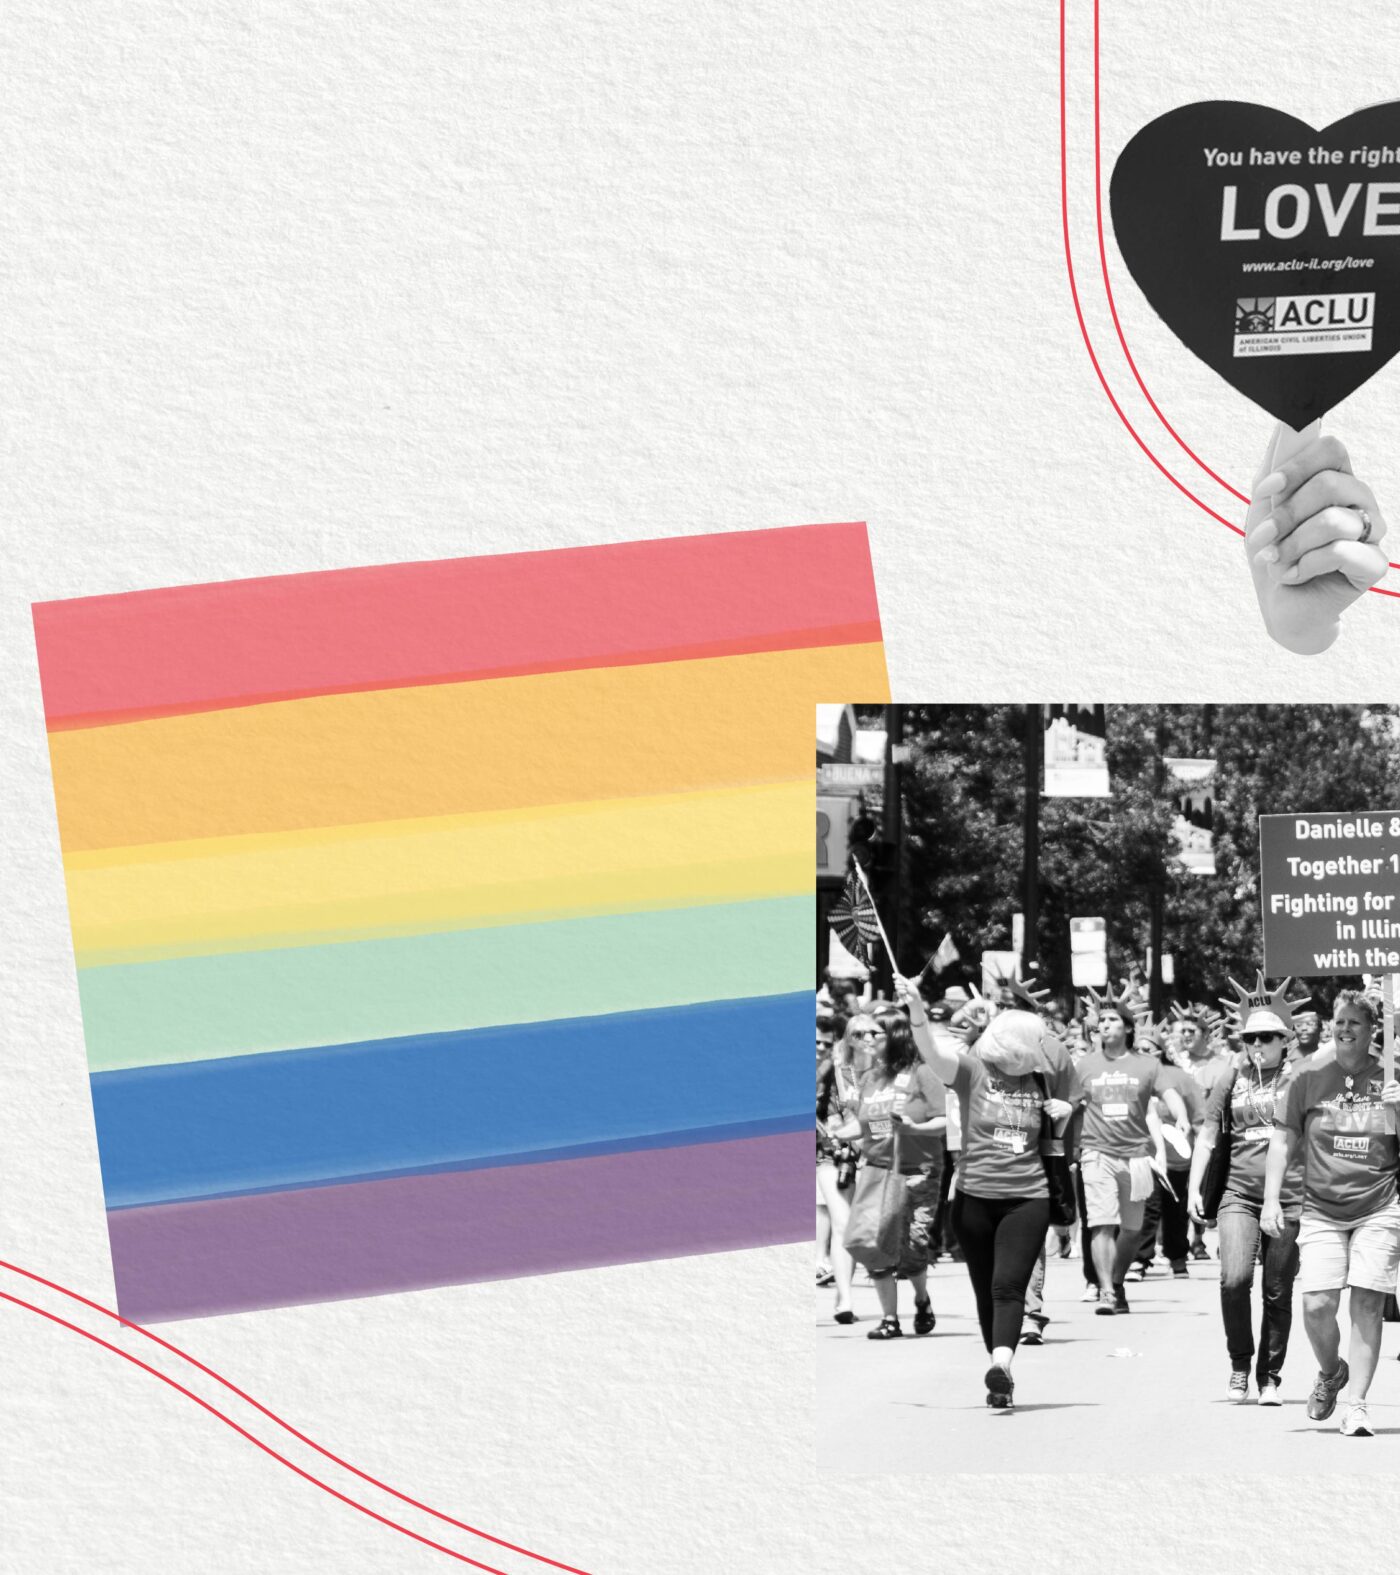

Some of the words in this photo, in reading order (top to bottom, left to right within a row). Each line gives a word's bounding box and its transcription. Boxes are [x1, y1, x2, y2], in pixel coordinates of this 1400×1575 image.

[1203, 147, 1243, 167] You
[1249, 146, 1302, 165] have
[1308, 146, 1344, 165] the
[1242, 256, 1375, 274] www.aclu-il.org/love
[1280, 297, 1369, 327] ACLU
[1239, 337, 1279, 345] AMERICAN
[1280, 336, 1300, 344] CIVIL
[1302, 335, 1341, 343] LIBERTIES
[1342, 333, 1367, 341] UNION
[1295, 818, 1383, 840] Danielle
[1287, 855, 1383, 880] Together
[1270, 893, 1358, 918] Fighting
[1363, 891, 1395, 910] for
[1336, 920, 1355, 940] in
[1314, 949, 1360, 969] with
[1365, 948, 1399, 967] the
[1248, 996, 1272, 1008] ACLU
[1336, 1139, 1366, 1149] ACLU
